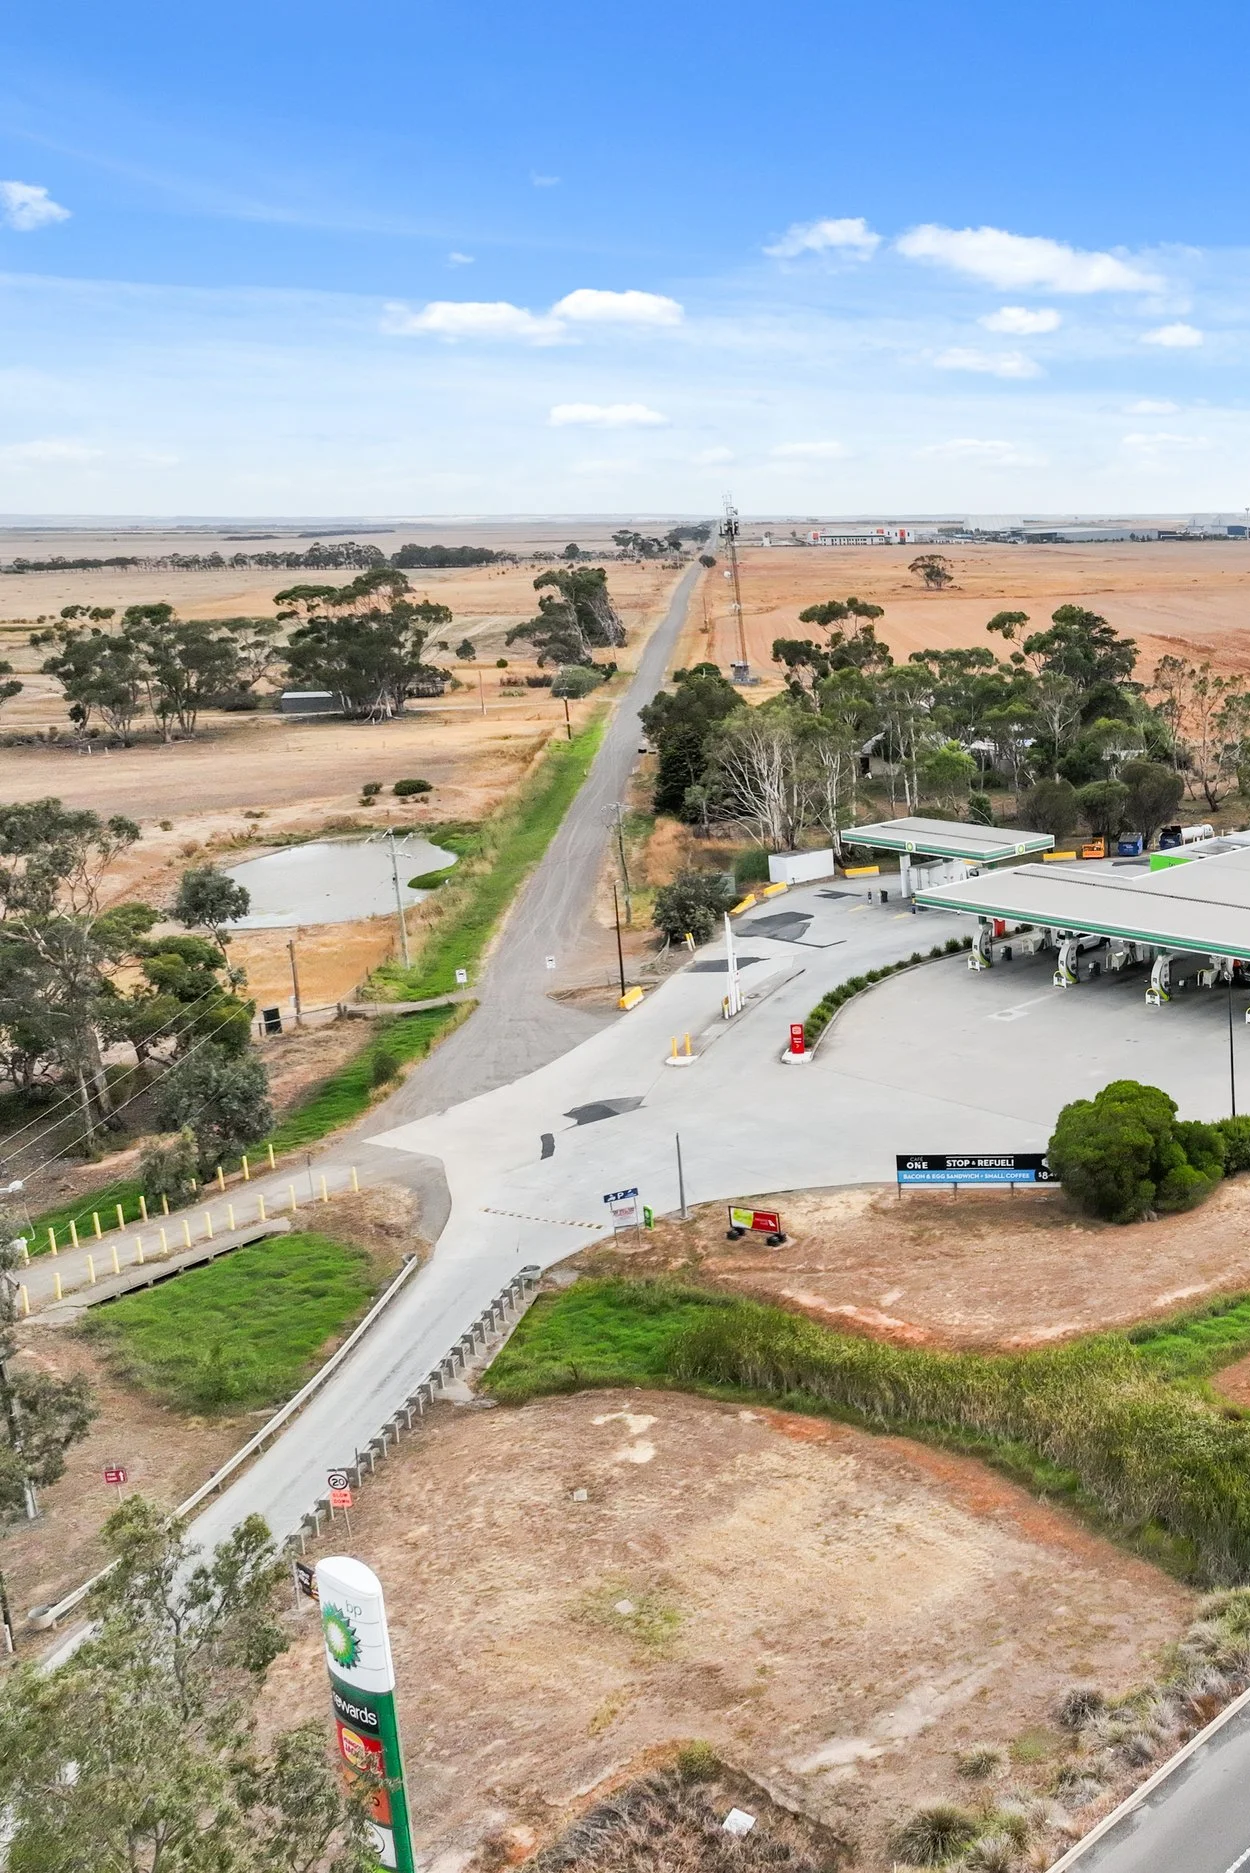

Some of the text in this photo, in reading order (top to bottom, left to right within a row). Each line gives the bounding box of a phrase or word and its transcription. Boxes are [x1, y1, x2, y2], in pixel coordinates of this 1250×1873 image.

[906, 1161, 928, 1169] ONE
[946, 1159, 970, 1167] STOP
[977, 1158, 1015, 1167] REFUEL!
[616, 1192, 624, 1200] P
[331, 1478, 345, 1487] 20
[345, 1599, 362, 1617] bp
